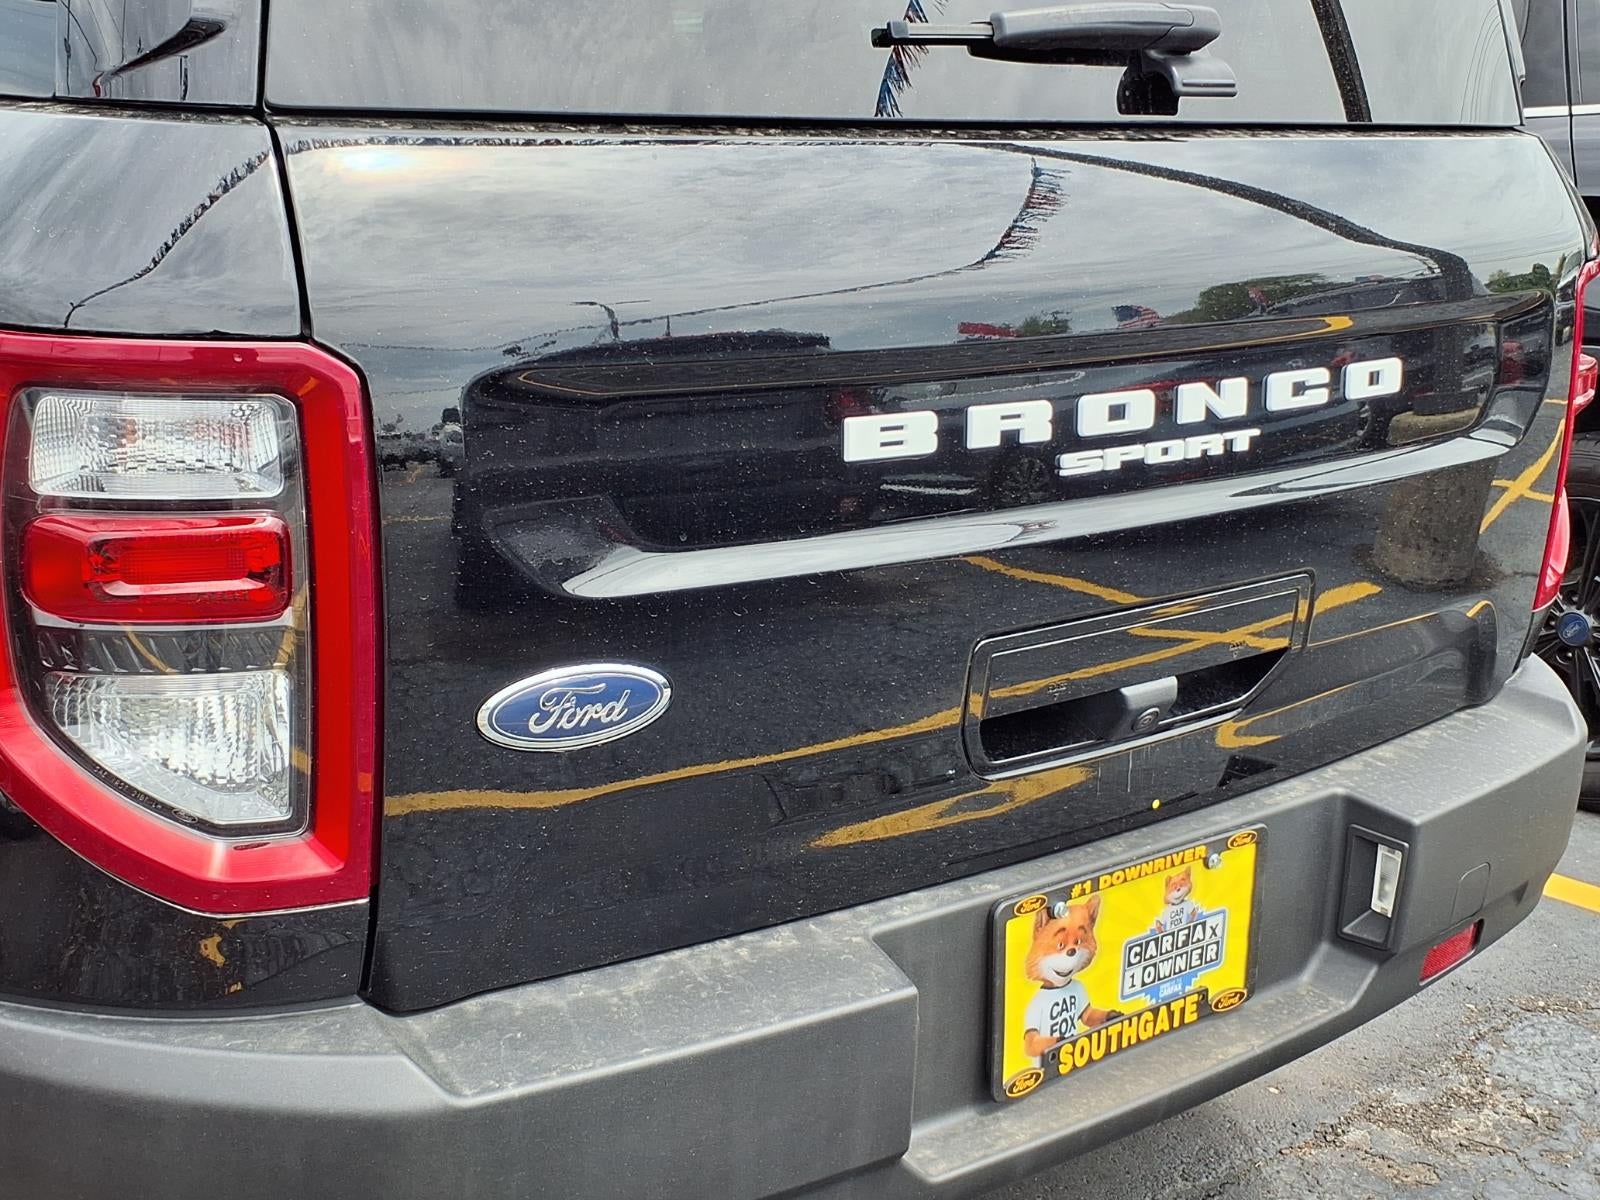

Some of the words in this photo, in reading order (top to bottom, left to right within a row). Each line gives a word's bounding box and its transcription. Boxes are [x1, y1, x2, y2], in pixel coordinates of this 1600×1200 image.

[842, 357, 1403, 463] BRONCO
[1054, 428, 1262, 477] SPORT
[528, 682, 631, 734] Ford
[1071, 880, 1092, 899] #1
[1099, 845, 1207, 890] DOWNRIVER
[1169, 907, 1184, 919] CAR
[1170, 918, 1183, 929] FOX
[1129, 923, 1219, 964] CARFAX
[1143, 943, 1218, 984] OWNER
[1050, 995, 1076, 1020] CAR
[1050, 1012, 1076, 1036] FOX
[1059, 994, 1199, 1075] SOUTHGATE
